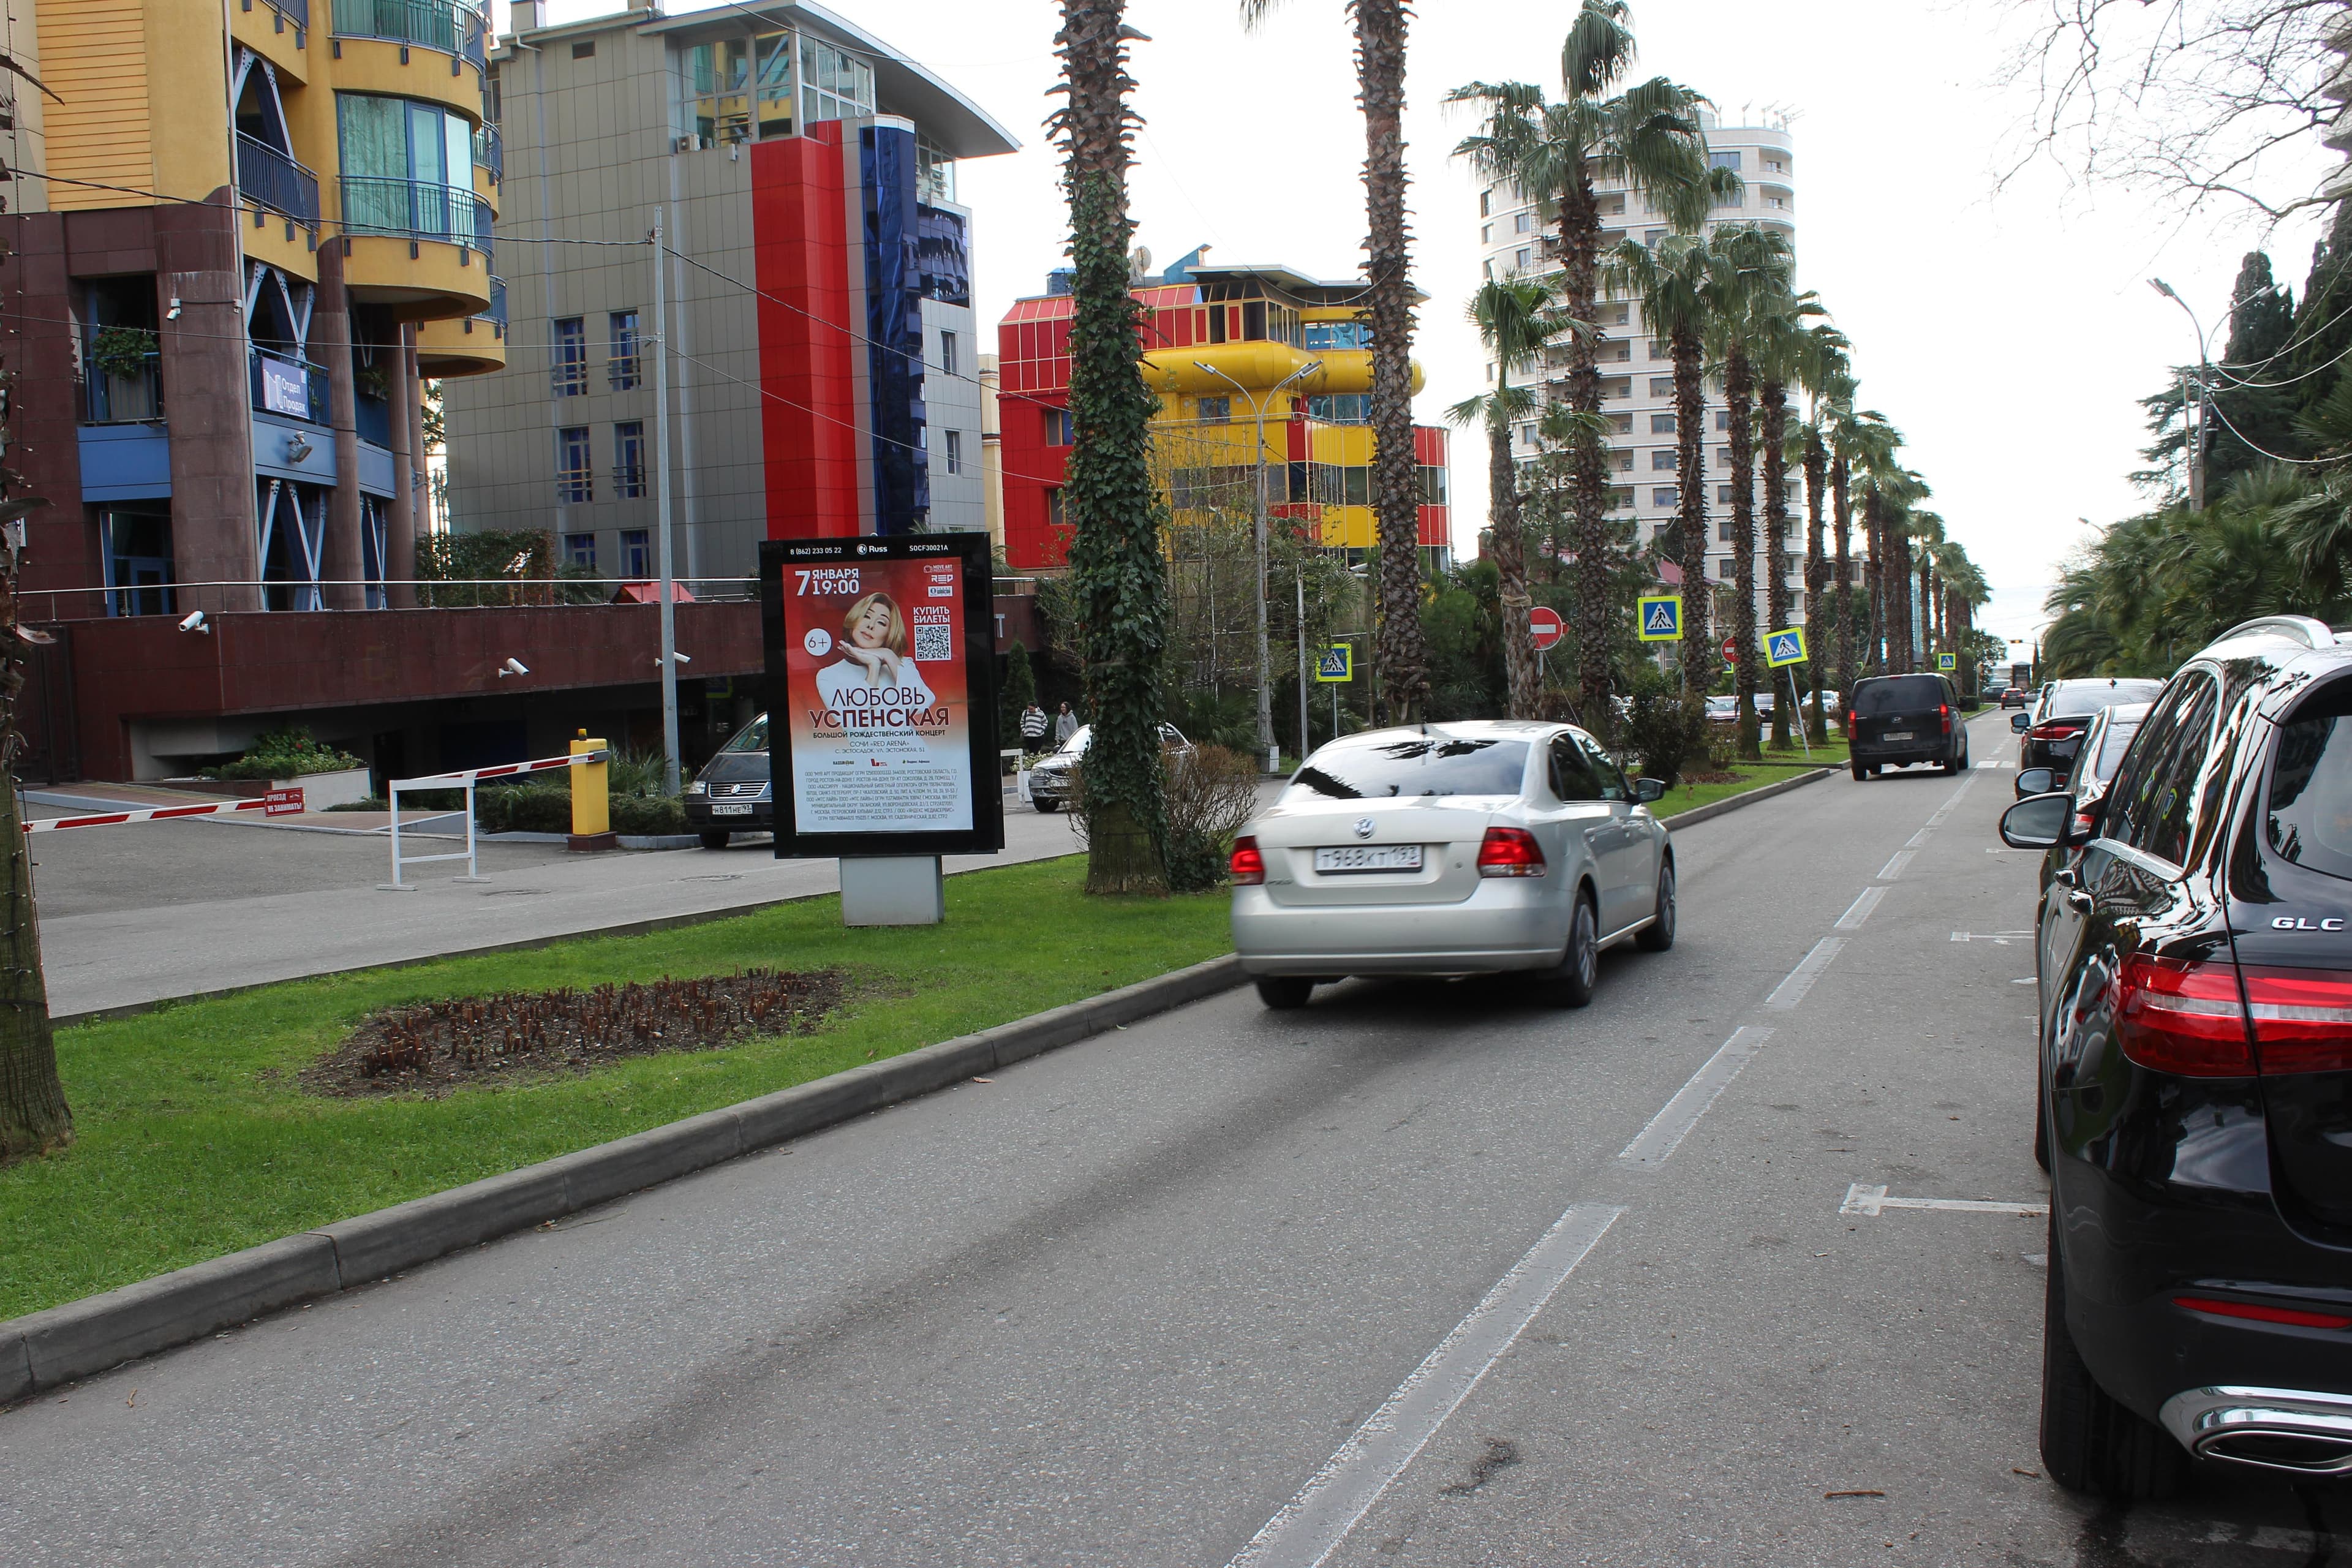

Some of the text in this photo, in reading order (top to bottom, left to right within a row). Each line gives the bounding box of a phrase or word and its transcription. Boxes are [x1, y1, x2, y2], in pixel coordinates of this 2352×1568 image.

[282, 377, 301, 394] Отдел
[812, 568, 859, 580] ЯНВАРЯ
[931, 575, 954, 584] RED
[795, 570, 810, 596] 7
[812, 579, 859, 595] 19:00
[913, 606, 950, 616] КУПИТЬ
[914, 614, 950, 624] БИЛЕТЫ
[808, 636, 827, 648] 6+
[831, 687, 925, 707] ЛЮБОВЬ
[809, 707, 949, 729] УСПЕНСКАЯ
[850, 729, 913, 737] РОЖДЕСТВЕНСКИЙ
[267, 793, 286, 802] ПРОЕЗД
[715, 805, 742, 814] Н811НЕ
[2271, 916, 2344, 931] GLC
